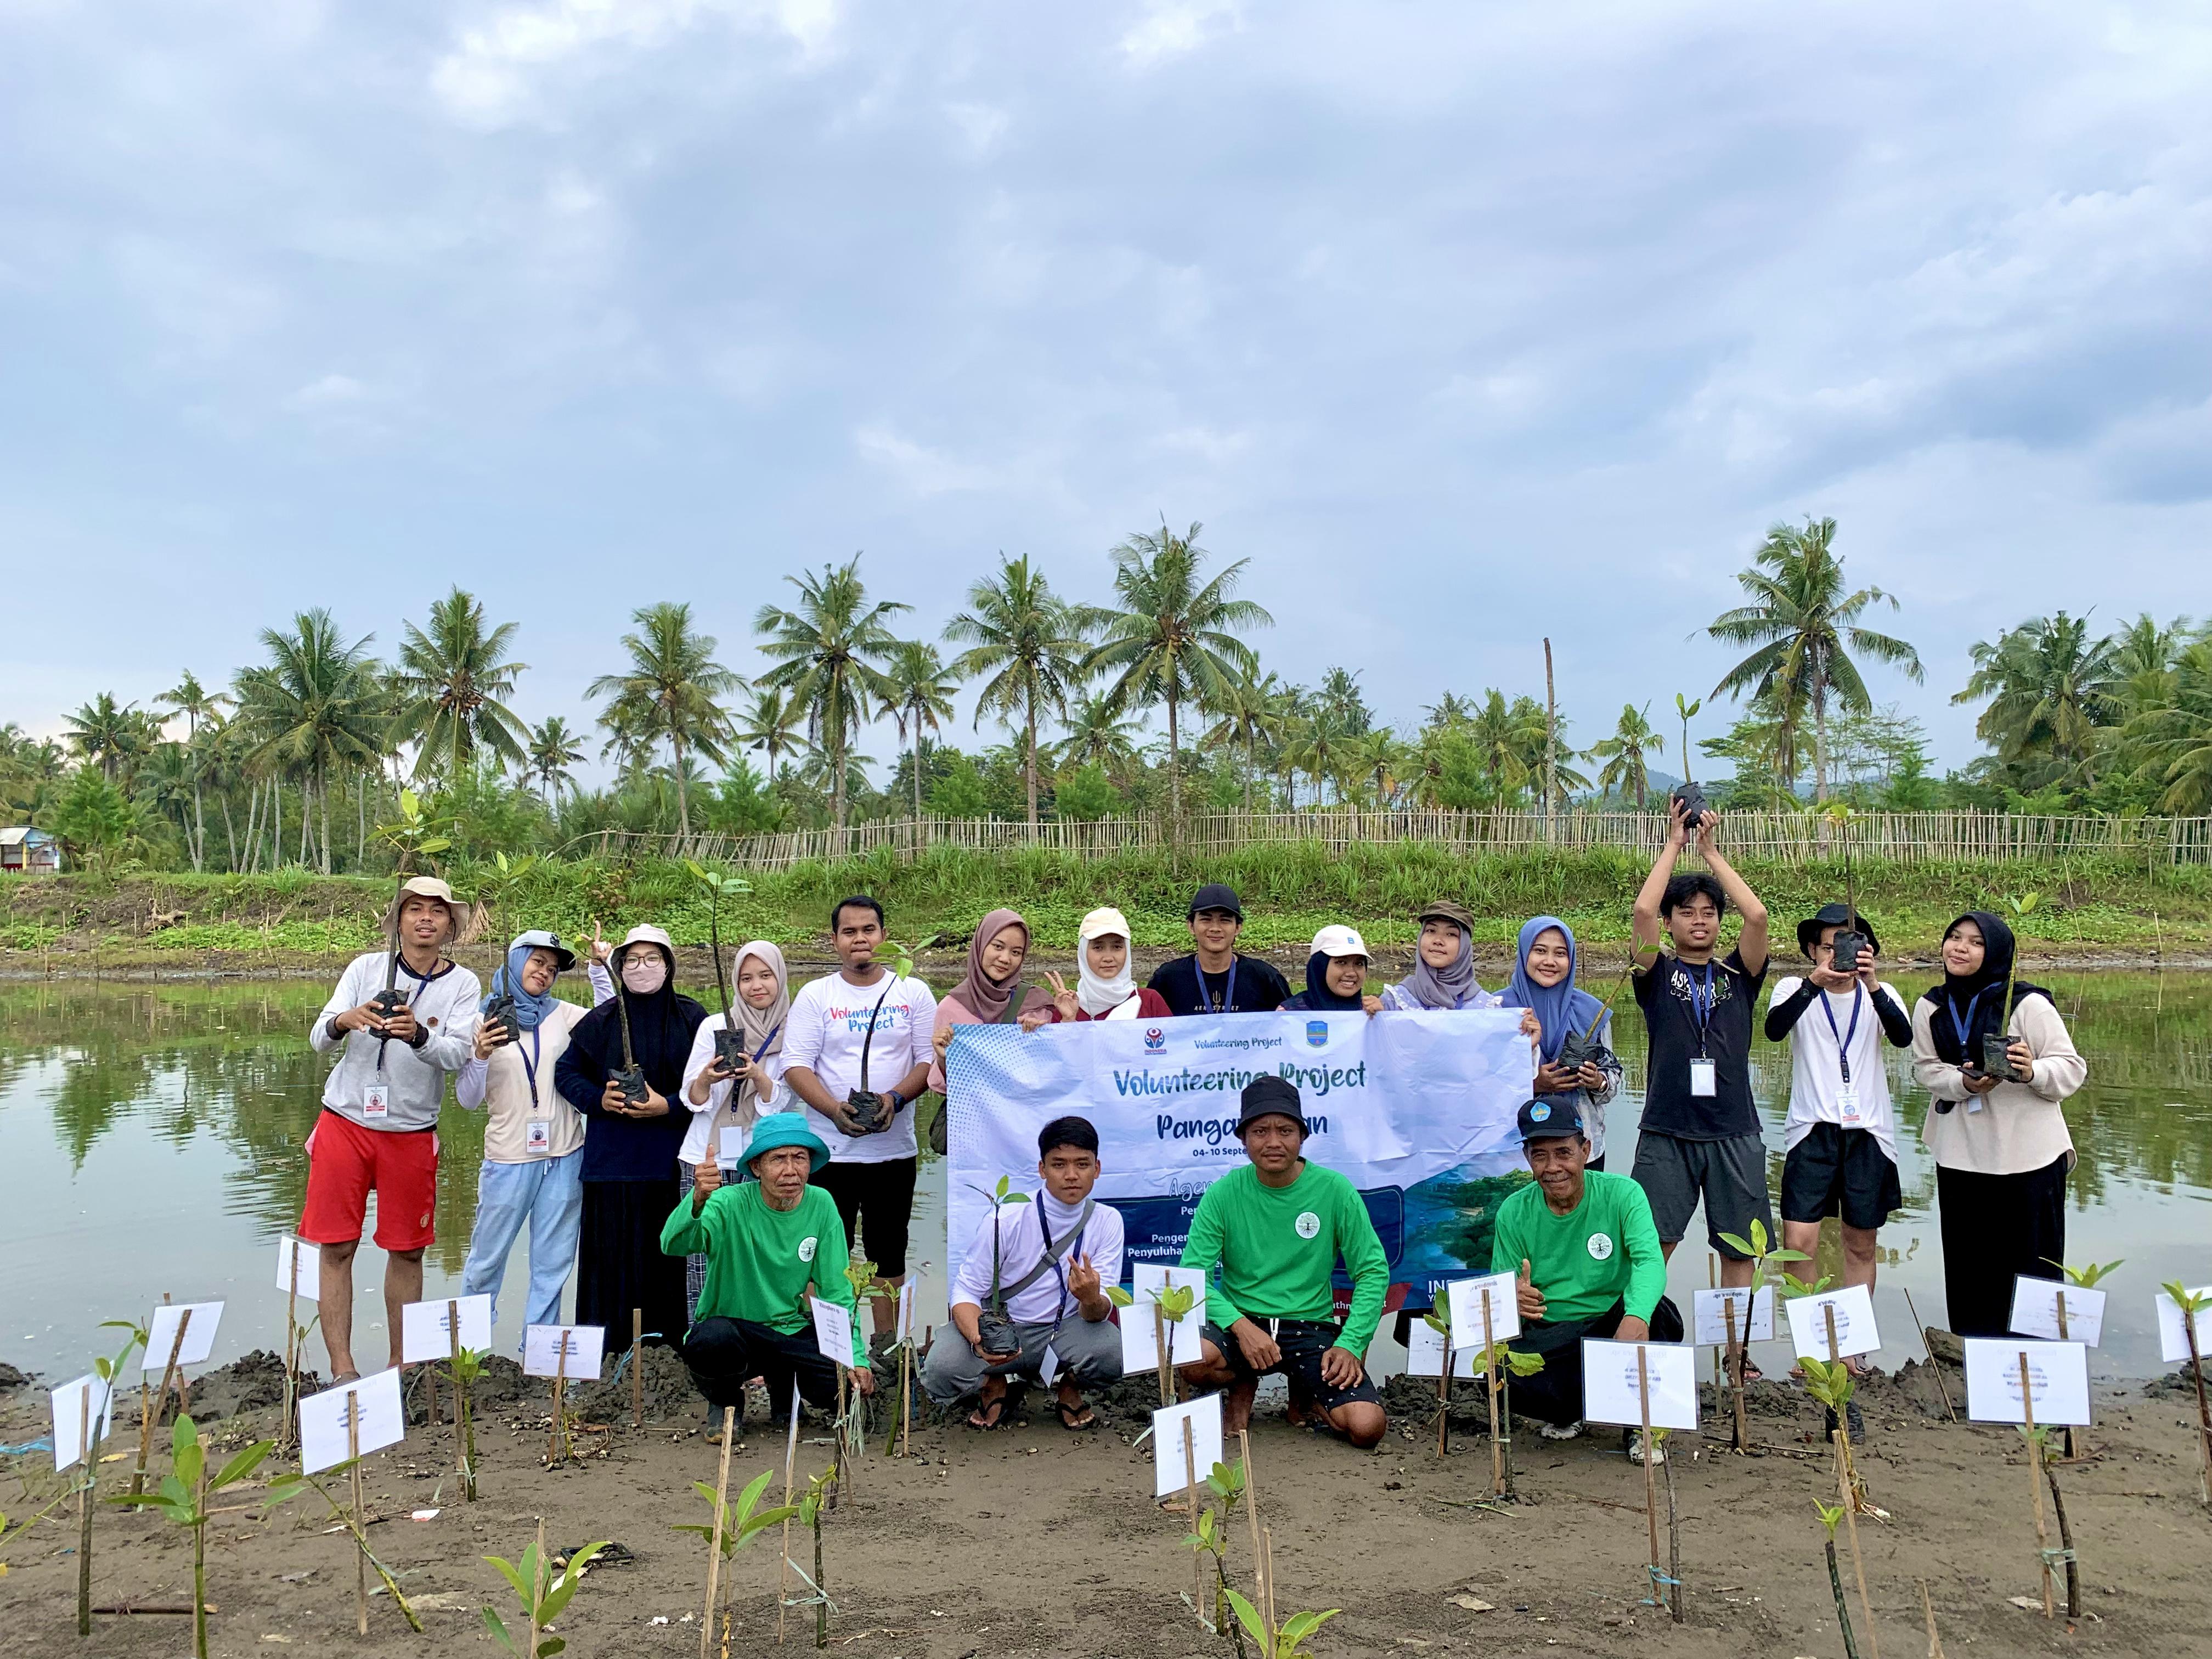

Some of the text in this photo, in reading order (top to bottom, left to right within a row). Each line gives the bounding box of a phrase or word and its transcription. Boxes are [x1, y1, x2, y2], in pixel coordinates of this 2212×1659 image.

[1194, 1036, 1282, 1050] Volunteering Project
[1279, 1060, 1366, 1096] Project
[1222, 1148, 1248, 1157] Septe
[1169, 1177, 1214, 1201] Agen
[1127, 1246, 1185, 1259] Penyuluha
